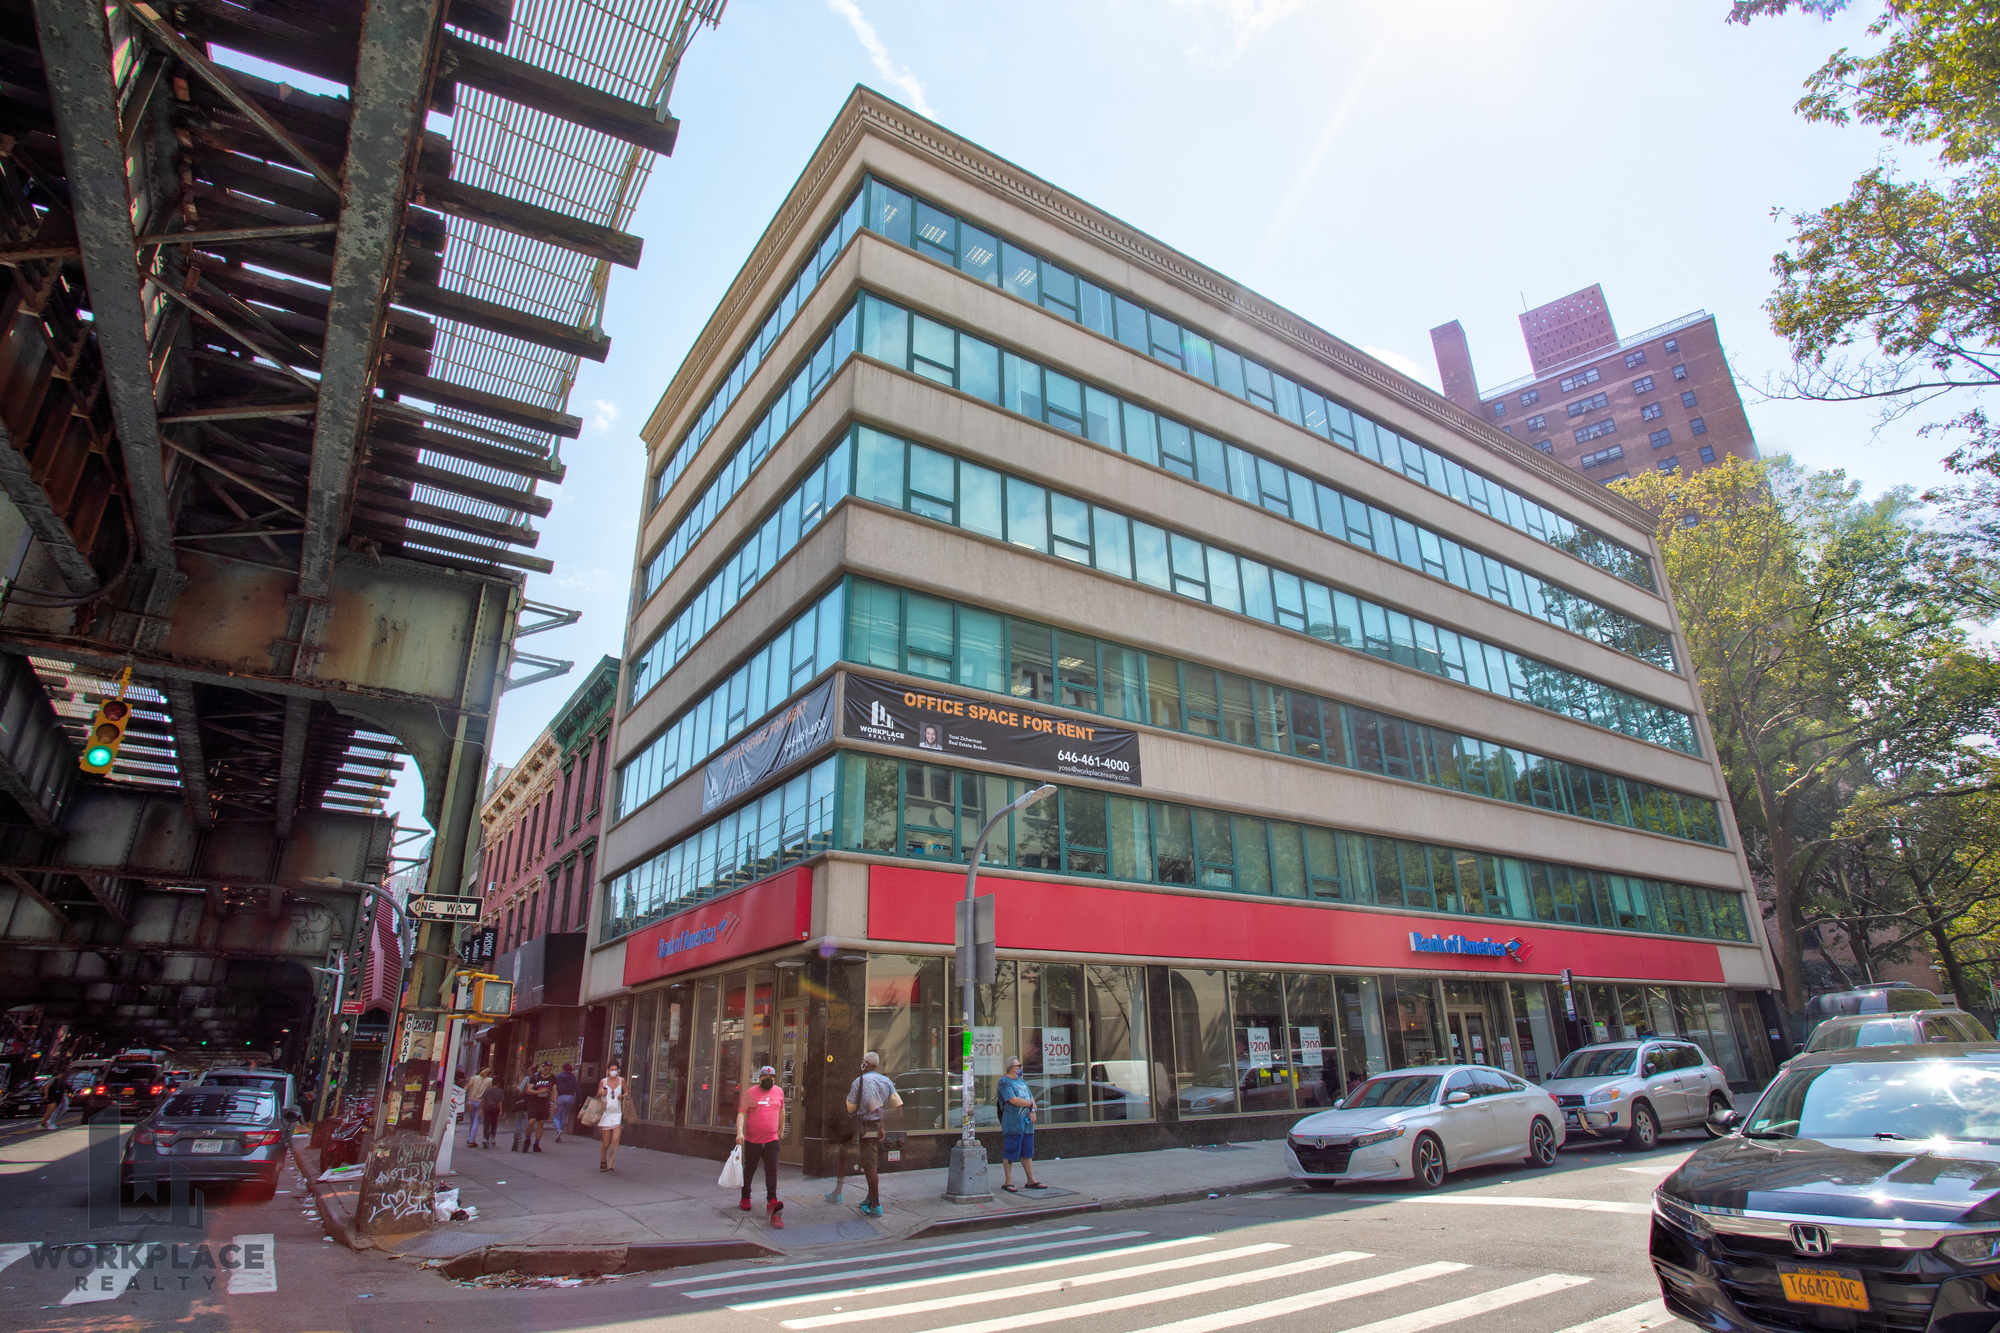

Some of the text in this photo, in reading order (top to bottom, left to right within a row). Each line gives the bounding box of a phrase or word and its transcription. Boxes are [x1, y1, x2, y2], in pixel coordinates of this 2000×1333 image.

[903, 692, 1095, 741] OFFICE SPACE FOR RENT
[722, 746, 745, 768] OFFICE
[745, 727, 768, 752] SPACE
[769, 717, 784, 738] FOR
[785, 700, 808, 726] RENT
[860, 725, 905, 739] WORKPLACE
[868, 733, 897, 742] REALTY
[1057, 749, 1130, 772] 646-461-4000
[1057, 765, 1131, 781] yossi@workplacerealty.com
[414, 901, 472, 914] ONE WAY
[658, 923, 716, 959] Bank of America
[1408, 932, 1507, 956] Bank of America
[974, 1043, 1002, 1056] $200
[1044, 1043, 1071, 1056] $200
[1249, 1041, 1270, 1053] $200
[1302, 1040, 1321, 1051] $200
[1797, 1267, 1840, 1277] NEW YORK
[1787, 1275, 1859, 1301] T664210C
